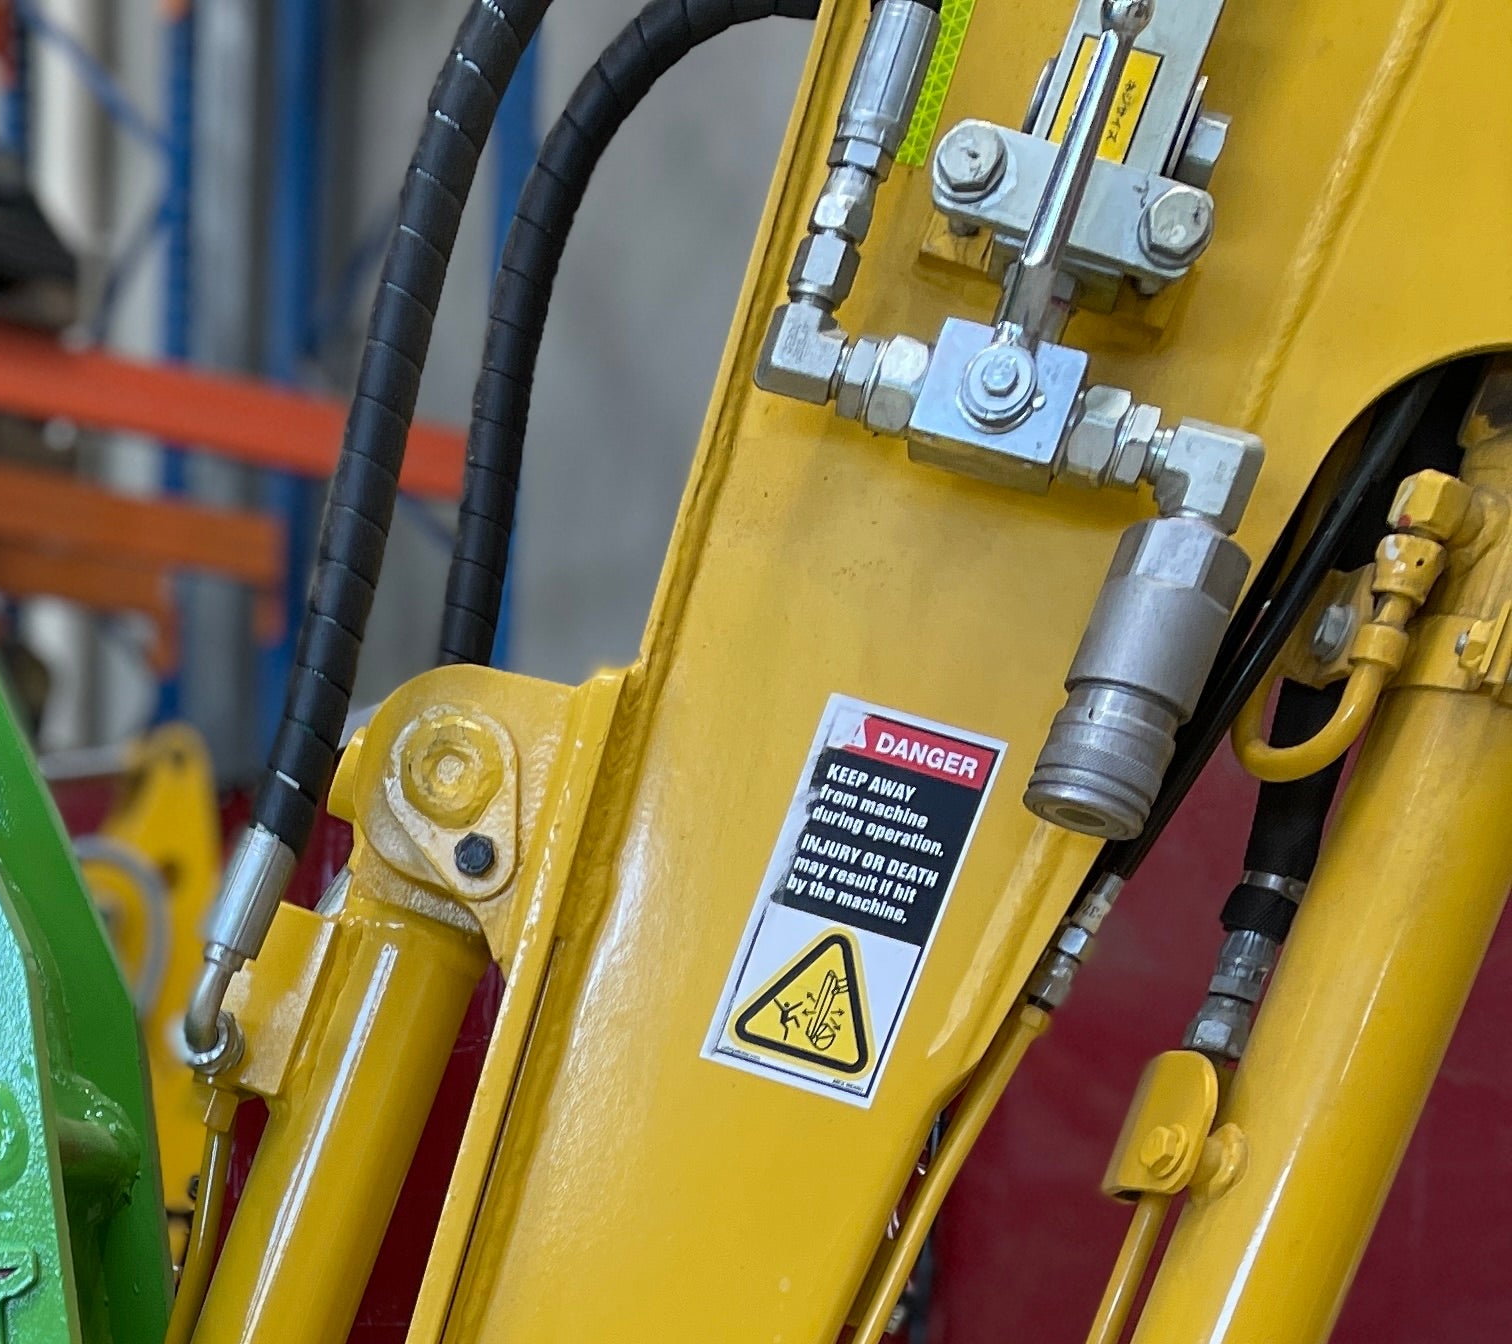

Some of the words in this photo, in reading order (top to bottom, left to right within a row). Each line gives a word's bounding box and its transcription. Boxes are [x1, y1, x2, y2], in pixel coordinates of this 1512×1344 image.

[873, 730, 982, 779] DANGER
[817, 782, 860, 809] from
[857, 794, 931, 830] machine
[824, 762, 870, 790] KEEP
[866, 774, 917, 804] AWAY
[809, 802, 866, 836] during
[862, 819, 948, 860] operation.
[791, 854, 830, 880] may
[827, 863, 880, 893] result
[876, 878, 894, 897] if
[891, 882, 919, 905] hit
[799, 832, 862, 866] INJURY
[859, 850, 887, 873] OR
[884, 858, 940, 889] DEATH
[784, 872, 809, 896] by
[805, 879, 837, 902] the
[834, 887, 911, 925] machine.
